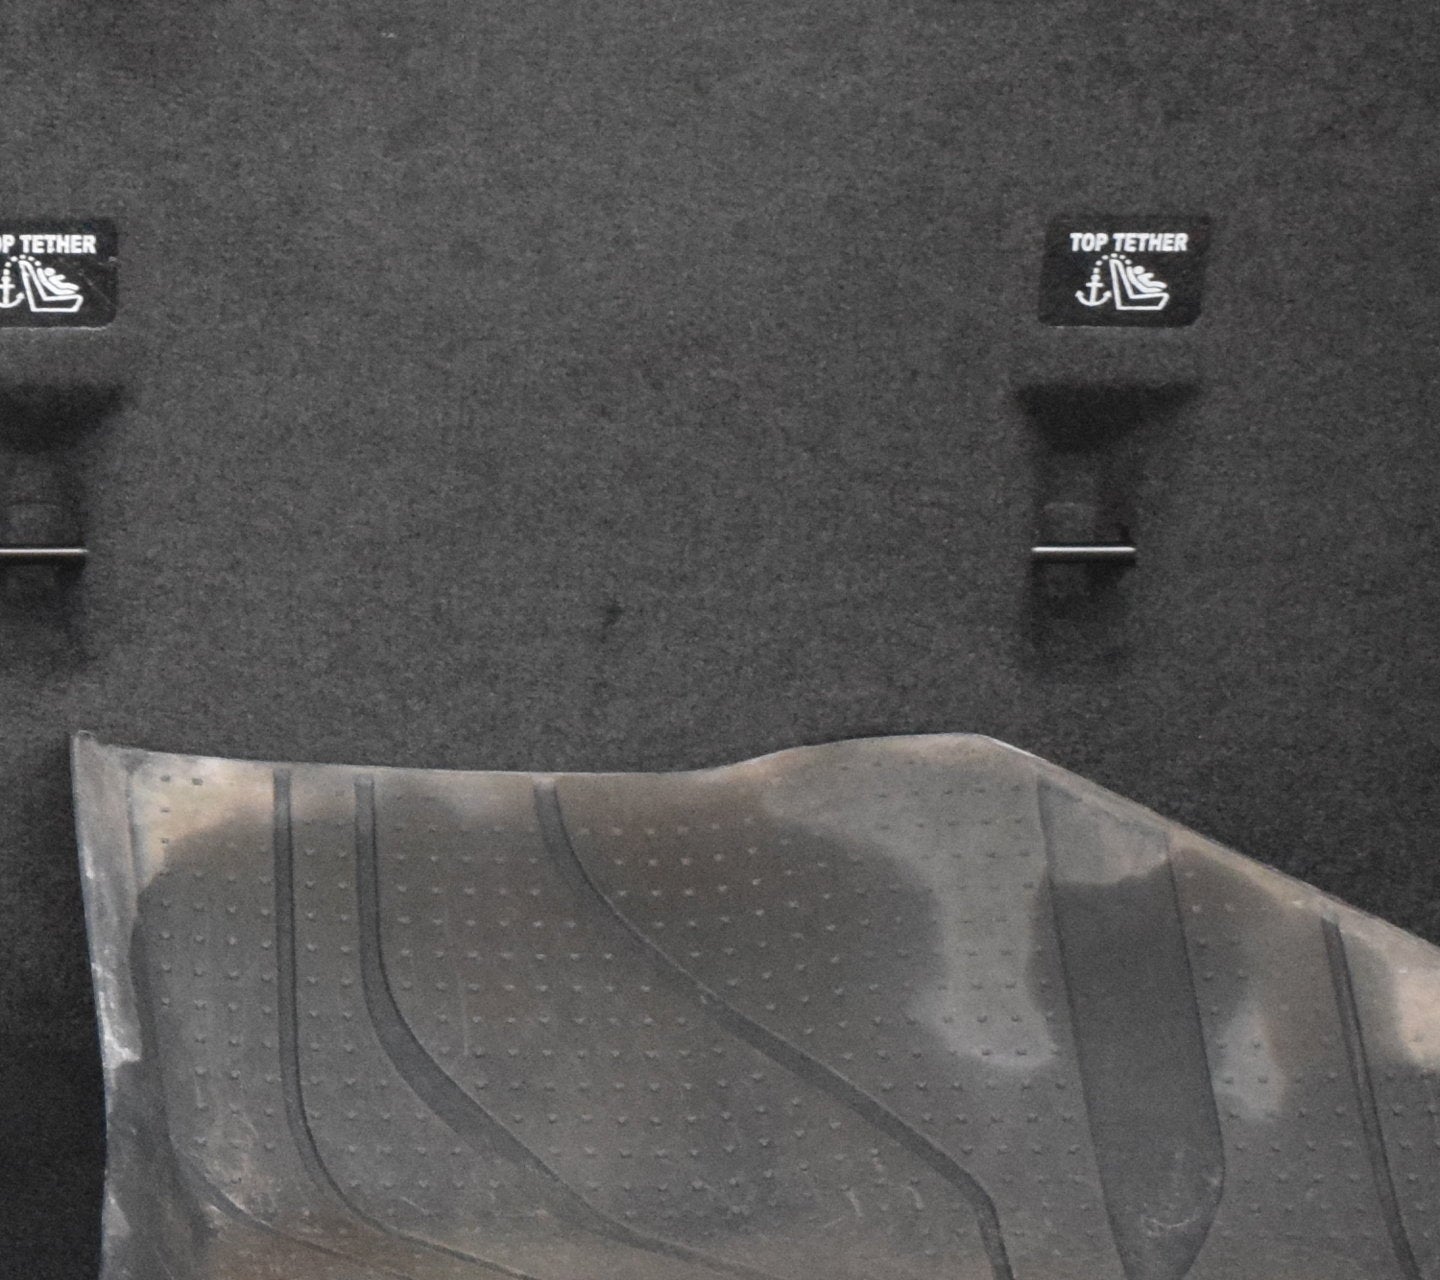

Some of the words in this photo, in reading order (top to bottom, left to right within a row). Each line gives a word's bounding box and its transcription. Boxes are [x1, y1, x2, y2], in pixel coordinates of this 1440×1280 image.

[20, 234, 97, 253] TETHER
[1070, 233, 1109, 251] TOP
[1112, 233, 1189, 251] TETHER
